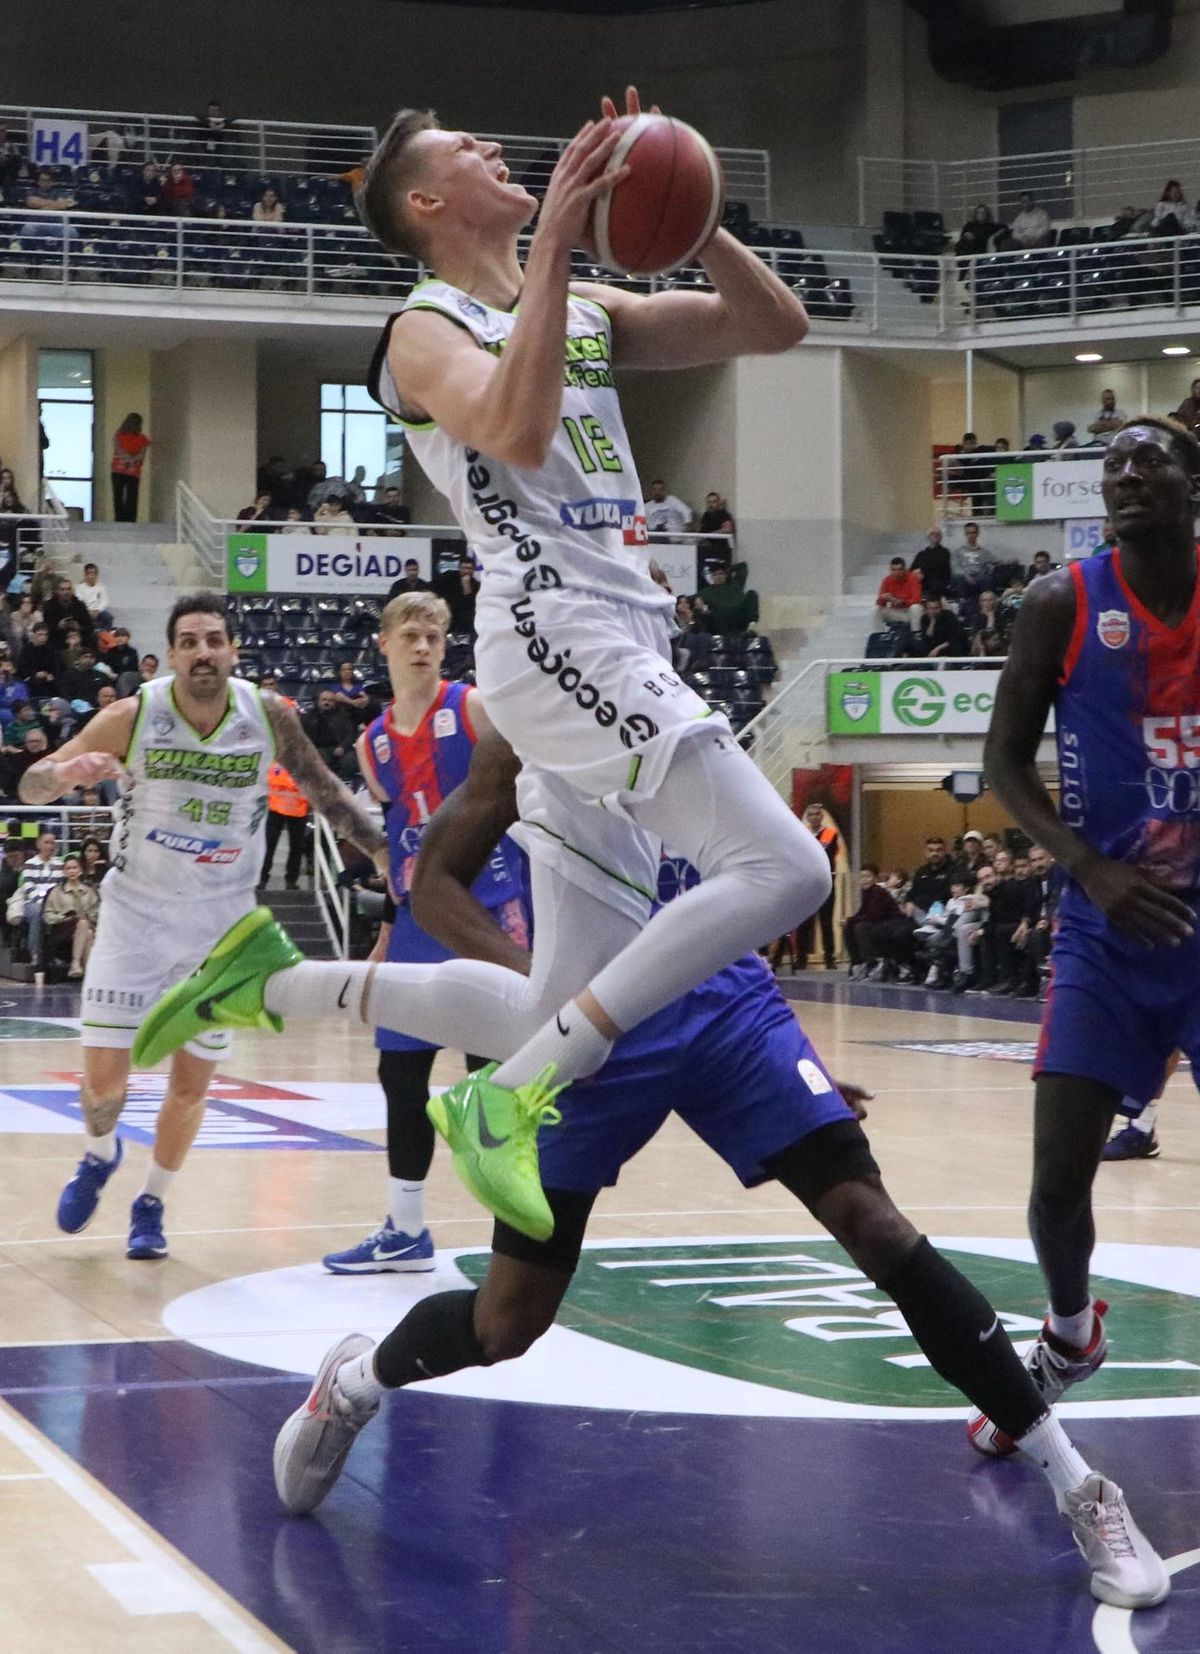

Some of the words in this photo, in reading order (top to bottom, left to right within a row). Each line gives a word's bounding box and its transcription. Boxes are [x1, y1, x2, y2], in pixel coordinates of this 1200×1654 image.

[36, 129, 83, 165] H4
[562, 415, 623, 474] 12
[1070, 525, 1099, 549] D5
[1062, 732, 1085, 828] LOTUS
[413, 790, 431, 824] 1
